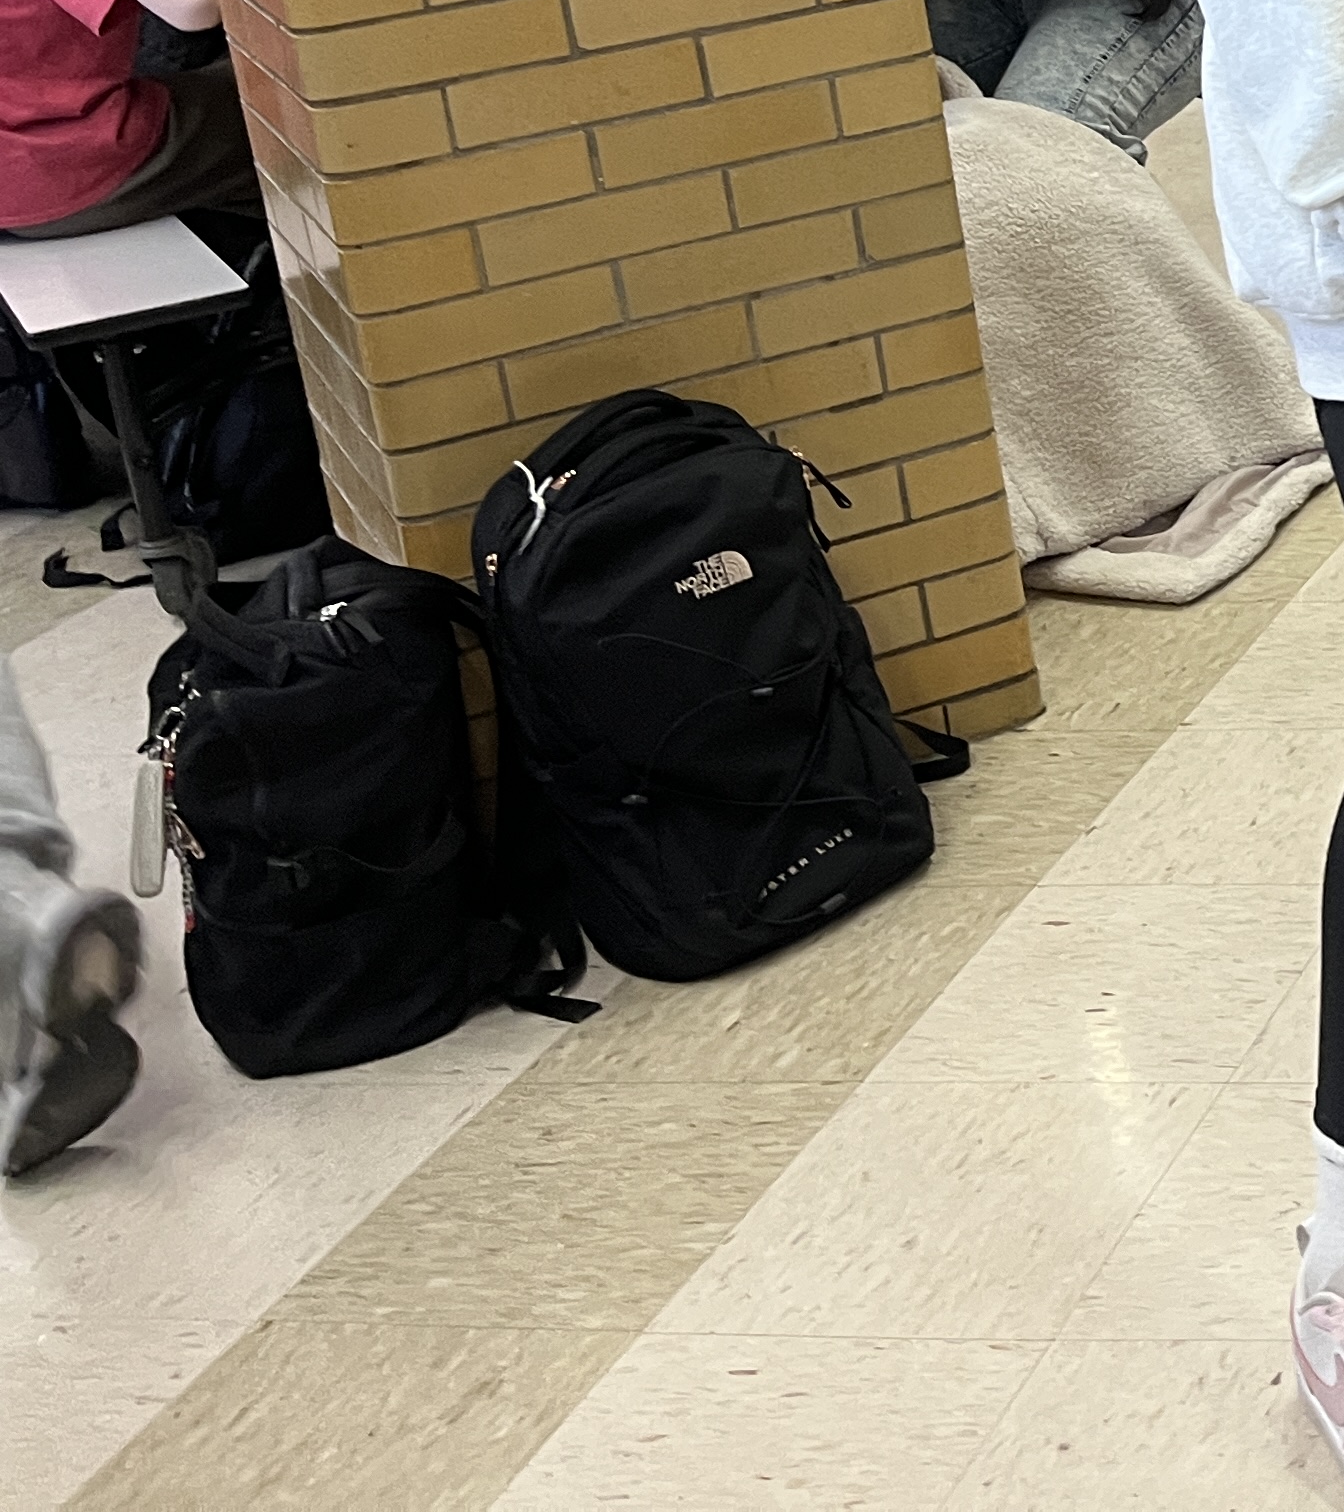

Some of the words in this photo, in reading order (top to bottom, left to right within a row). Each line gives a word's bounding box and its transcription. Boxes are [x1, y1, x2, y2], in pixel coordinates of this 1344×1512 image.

[692, 553, 724, 573] THE
[673, 565, 728, 595] NORTH
[692, 575, 731, 601] FACE
